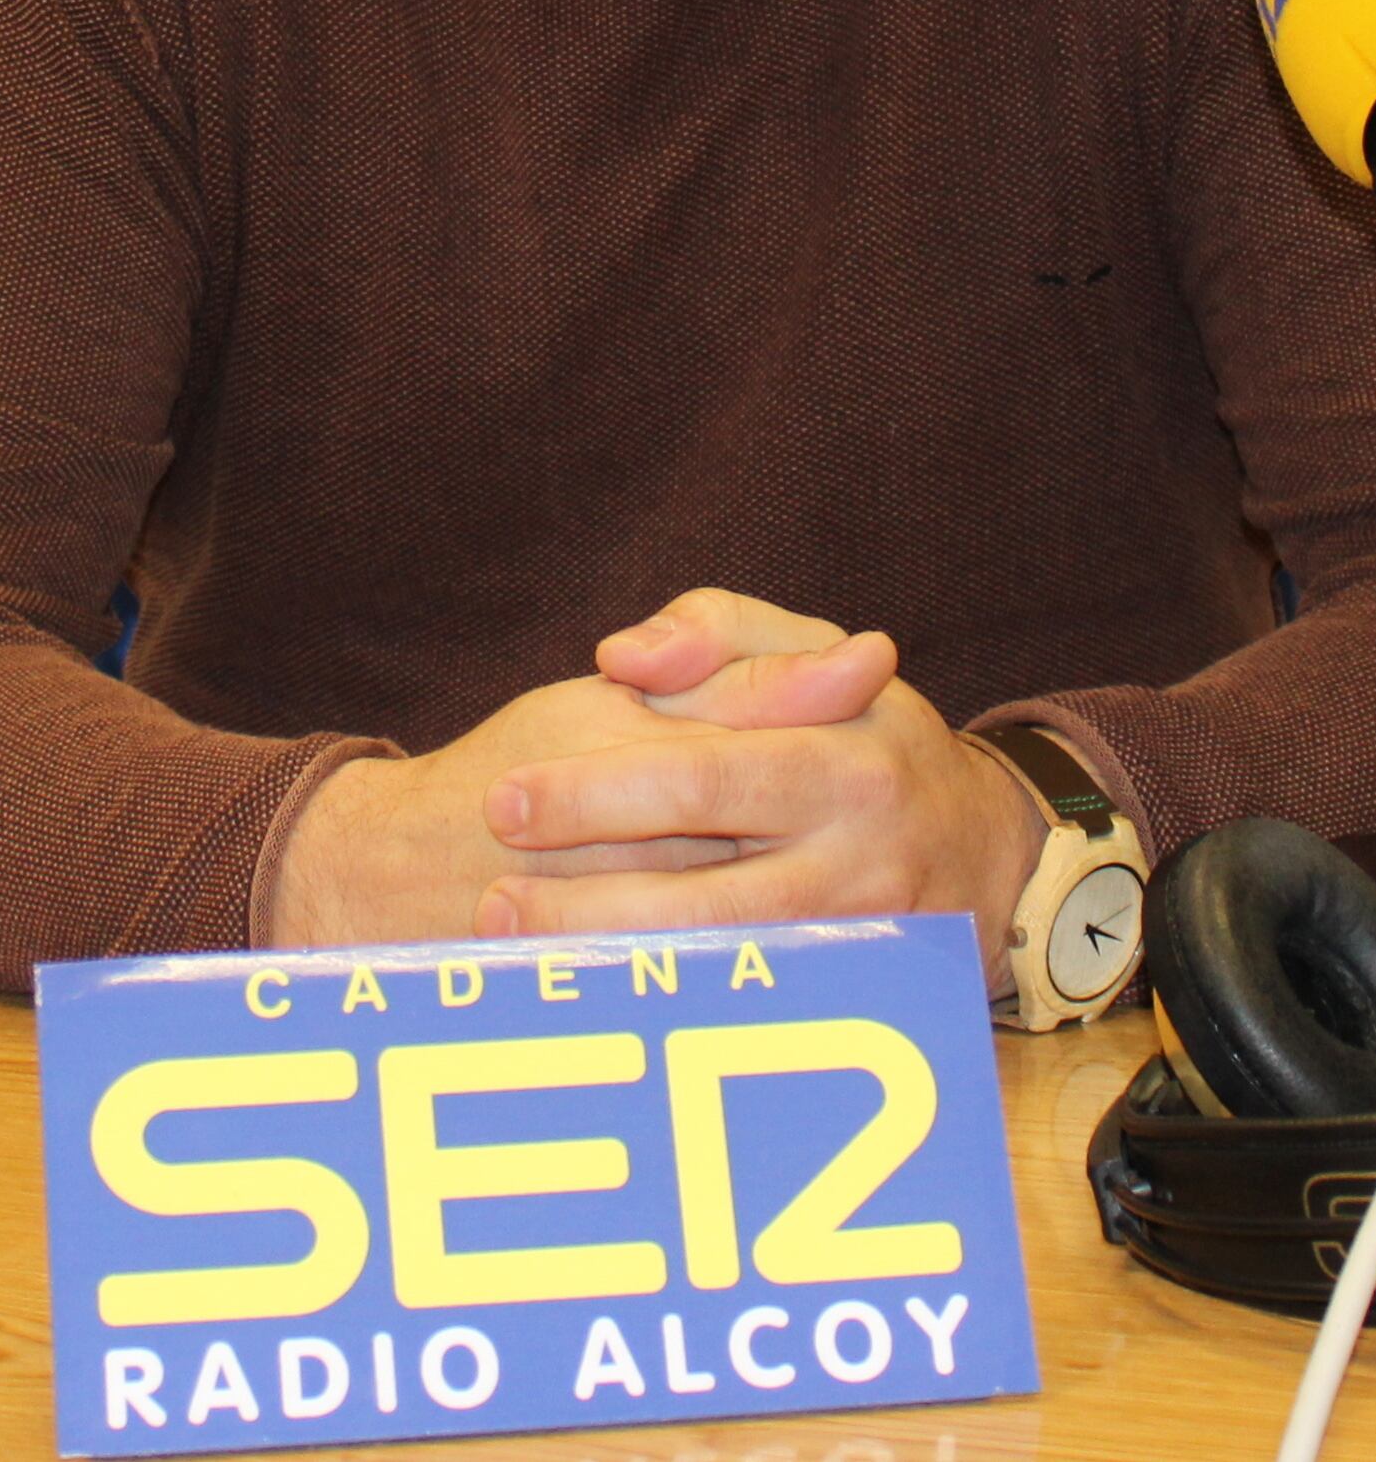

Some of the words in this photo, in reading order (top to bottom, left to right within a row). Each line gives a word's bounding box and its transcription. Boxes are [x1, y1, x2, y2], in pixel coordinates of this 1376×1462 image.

[245, 941, 775, 1020] CADENA
[90, 1019, 964, 1328] SER
[103, 1325, 501, 1431] RADIO
[574, 1294, 970, 1402] ALCOY
